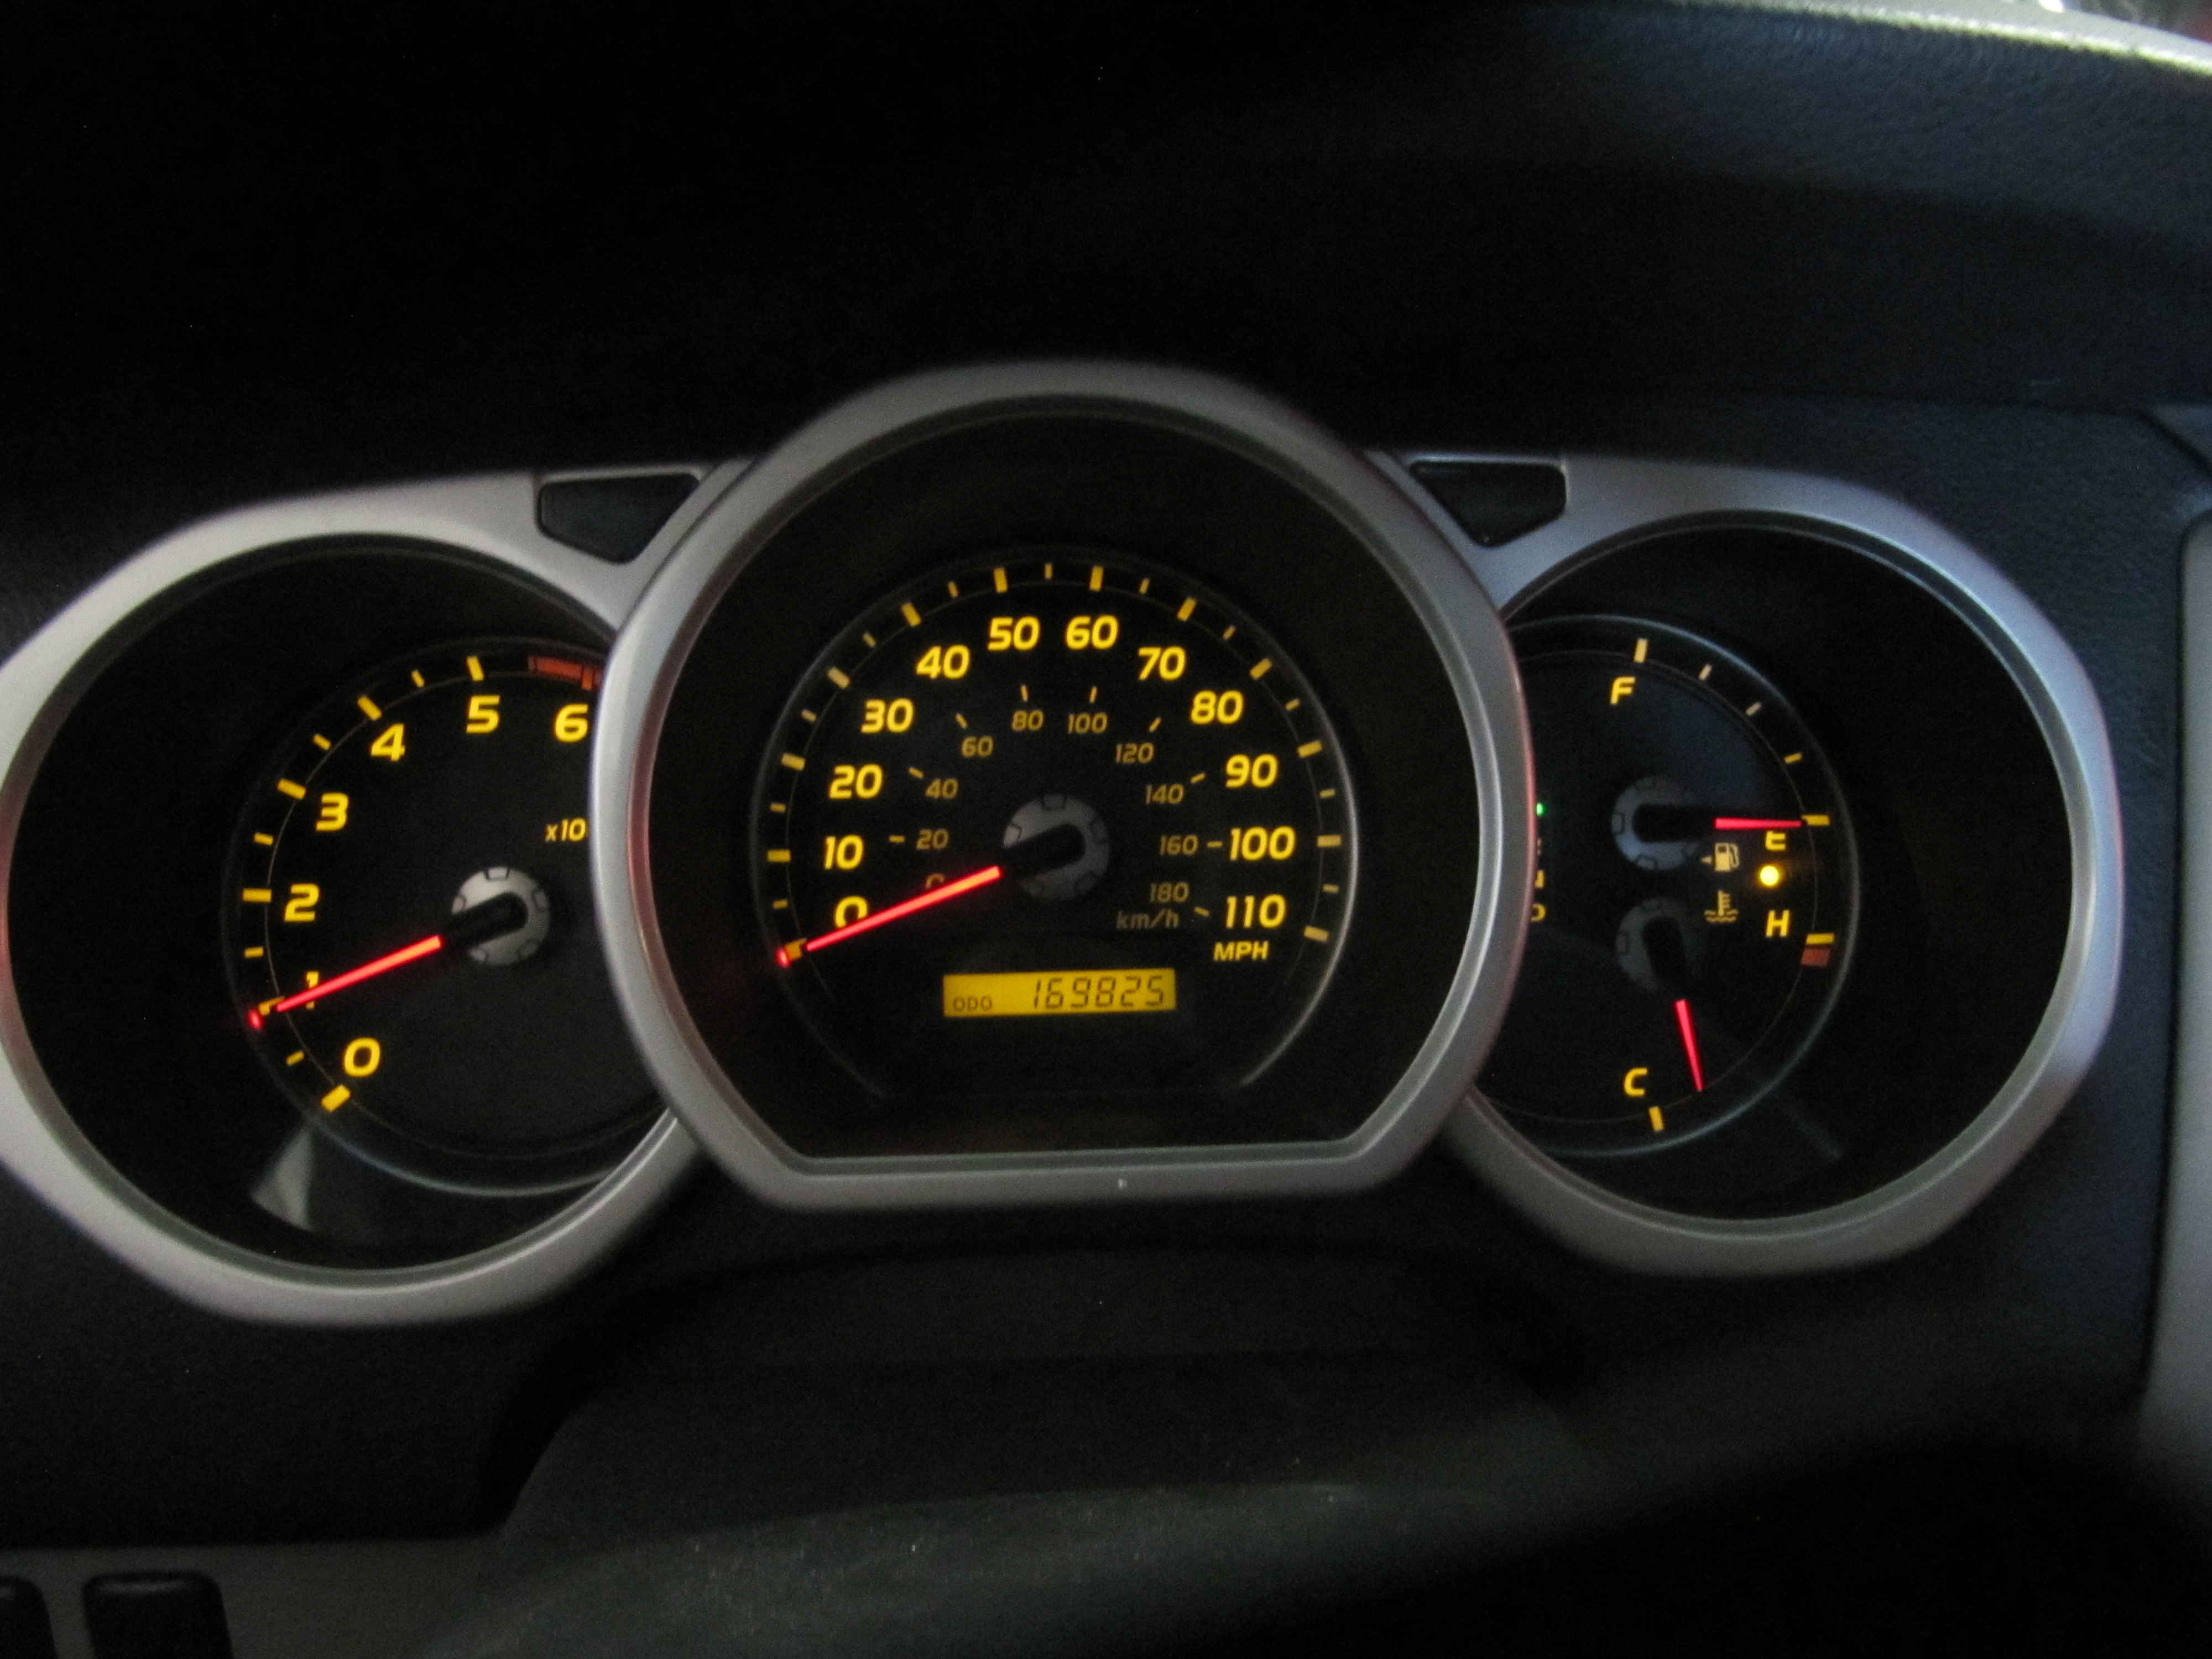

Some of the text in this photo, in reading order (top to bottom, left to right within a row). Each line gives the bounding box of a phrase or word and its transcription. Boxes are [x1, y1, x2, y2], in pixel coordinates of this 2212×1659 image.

[988, 617, 1040, 650] 50
[1066, 615, 1118, 649] 60
[916, 645, 970, 679] 40
[1139, 646, 1186, 680] 70
[1610, 677, 1635, 704] F
[467, 695, 499, 733] 5
[554, 704, 588, 742] 6
[862, 698, 914, 733] 30
[1011, 710, 1044, 731] 80
[1068, 713, 1108, 733] 100
[1191, 691, 1243, 724] 80
[371, 724, 405, 760] 4
[961, 736, 993, 757] 60
[1117, 743, 1154, 763] 120
[829, 764, 883, 799] 20
[1226, 754, 1277, 787] 90
[926, 779, 958, 798] 40
[1146, 784, 1184, 804] 140
[316, 793, 348, 831] 3
[825, 835, 863, 869] 10
[916, 830, 948, 849] 20
[1161, 835, 1198, 855] 160
[1230, 826, 1295, 860] 100
[1765, 831, 1786, 851] E
[285, 884, 319, 921] 2
[1151, 882, 1190, 902] 180
[1118, 908, 1180, 928] km/h
[1227, 894, 1286, 928] 110
[1766, 910, 1790, 936] H
[1214, 941, 1269, 960] MPH
[953, 975, 1164, 1013] ODO 169825
[343, 1038, 380, 1077] 0
[1624, 1068, 1647, 1097] C
